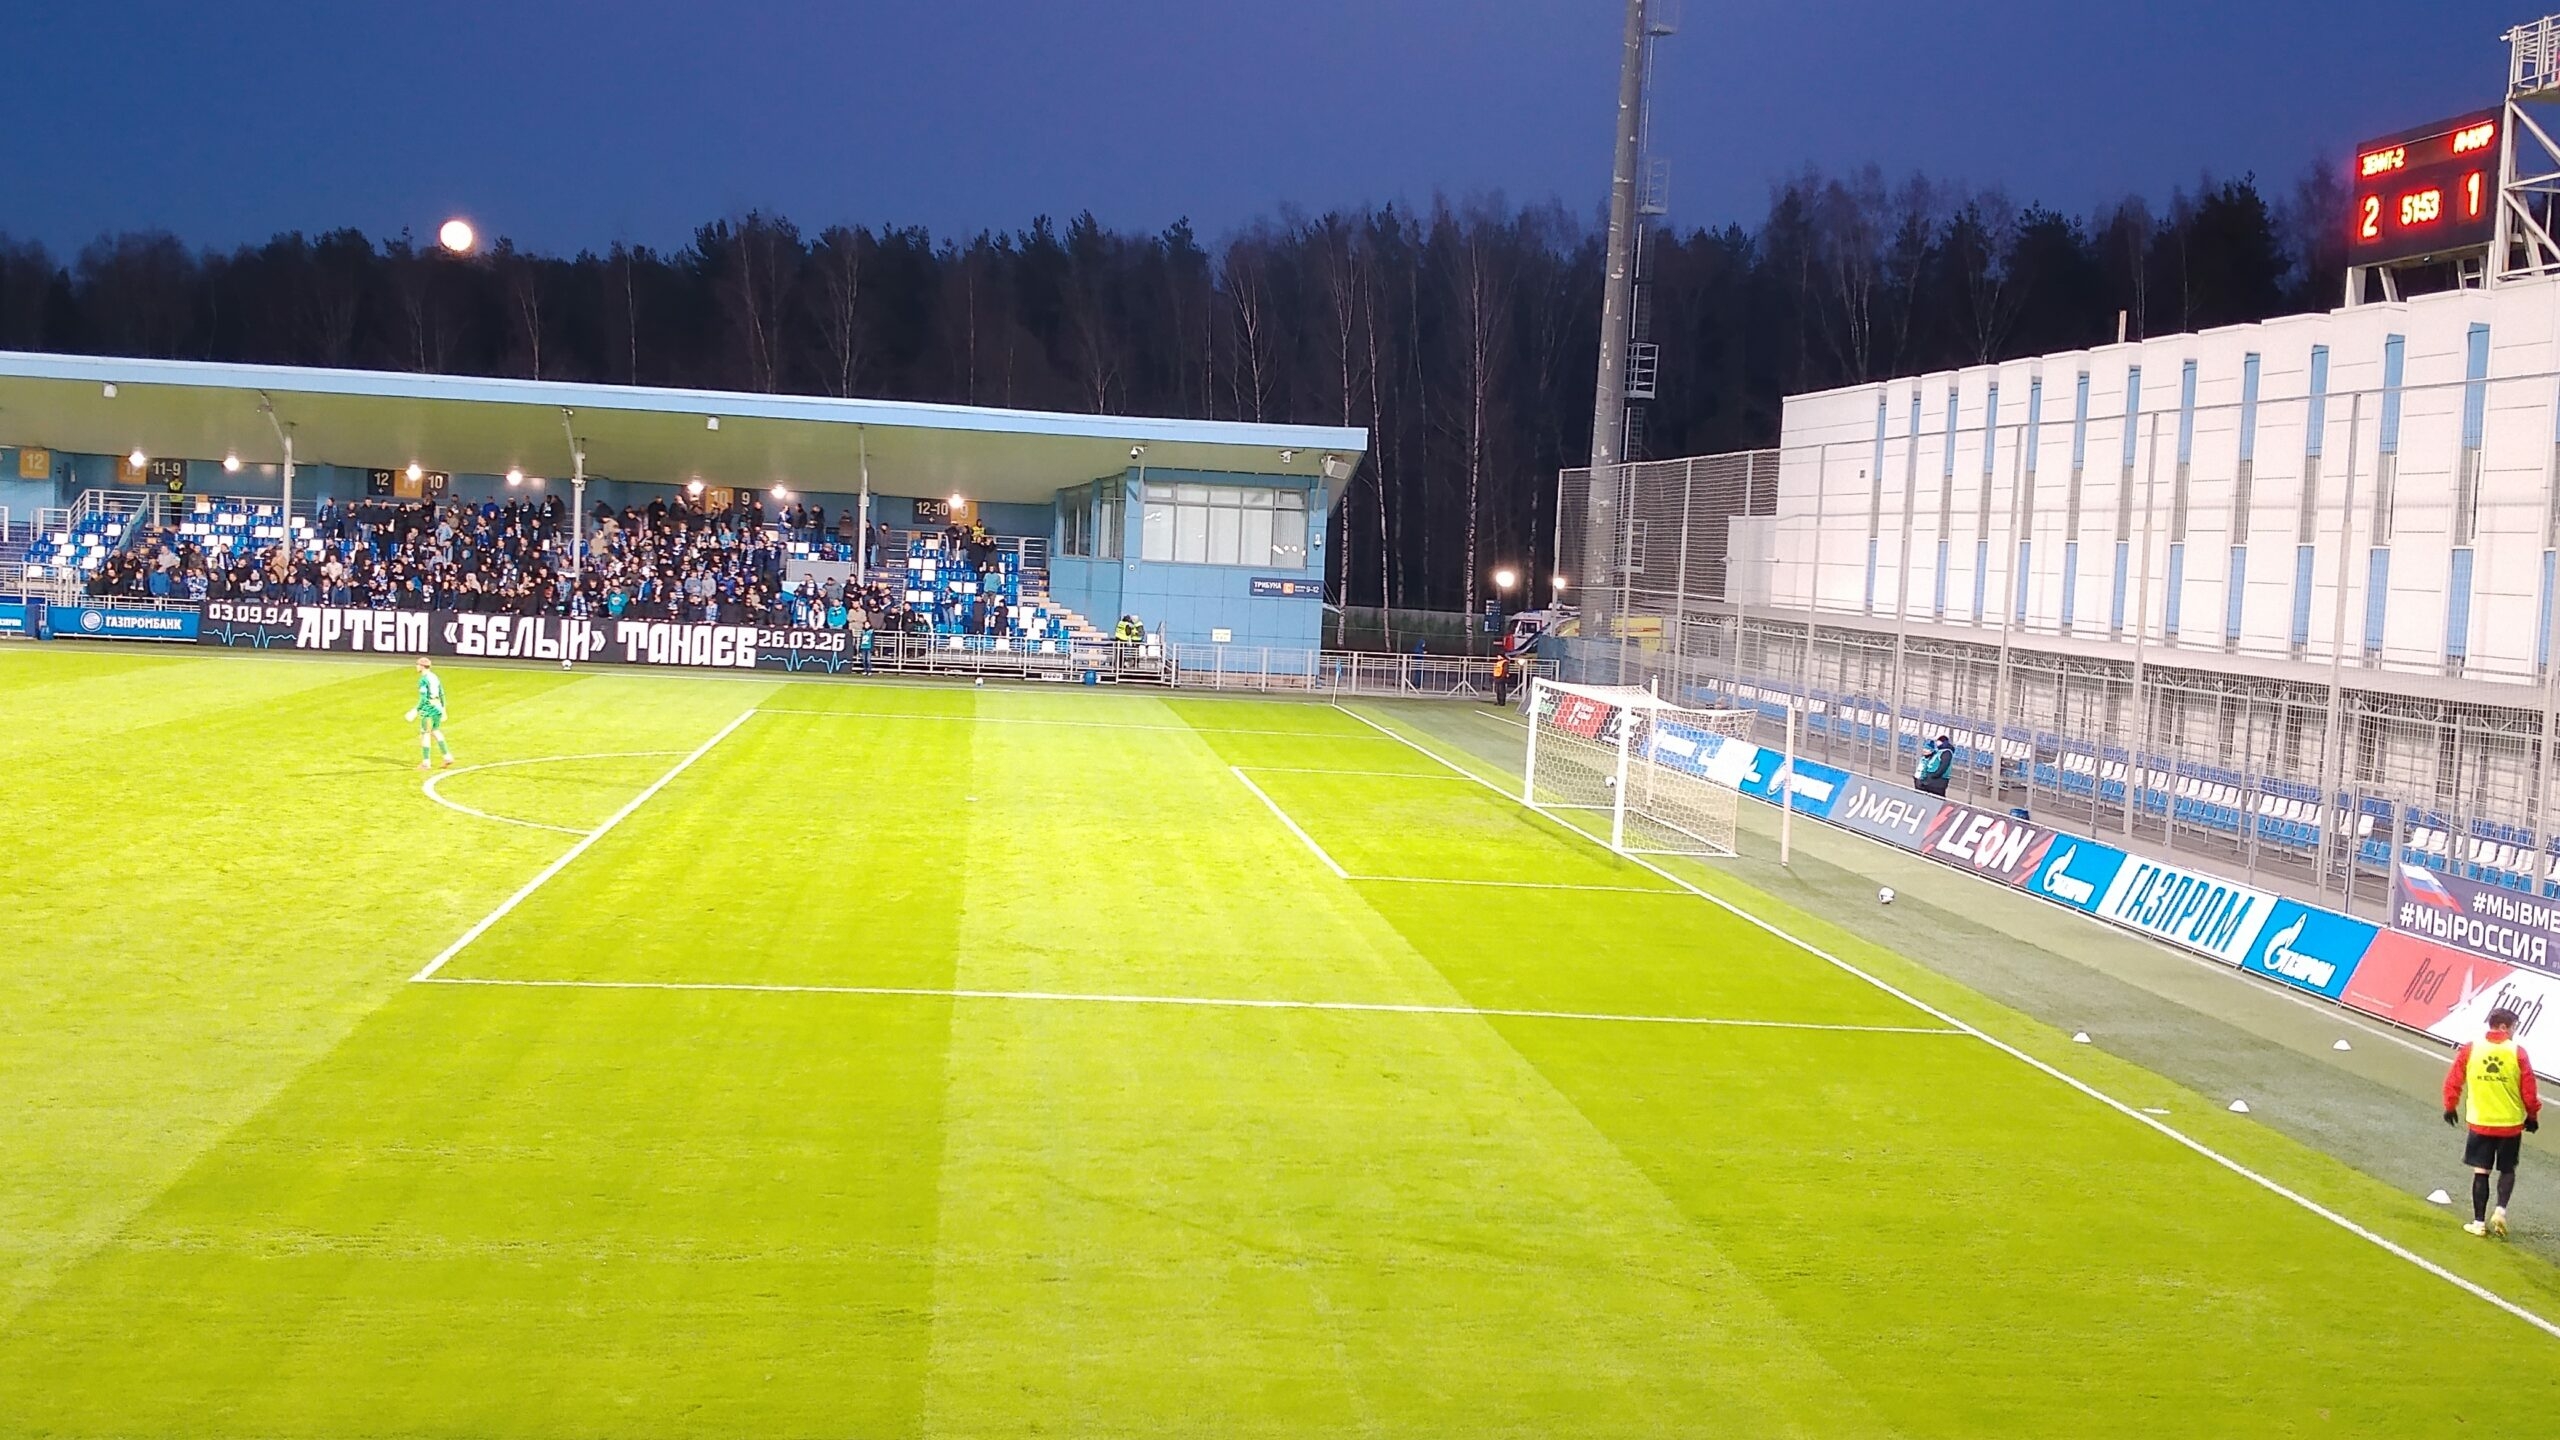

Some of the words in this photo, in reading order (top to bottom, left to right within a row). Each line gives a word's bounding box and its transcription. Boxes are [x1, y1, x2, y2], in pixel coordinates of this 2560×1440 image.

[2467, 172, 2481, 216] 1
[2362, 195, 2380, 238] 2
[26, 453, 44, 470] 12
[152, 461, 182, 477] 11-9
[374, 472, 390, 487] 12
[427, 475, 444, 489] 10
[741, 491, 751, 505] 9
[916, 502, 949, 516] 12-10
[1254, 581, 1282, 589] ТРИБУНА
[105, 616, 182, 631] ГАЗПРОМБАНК
[208, 603, 294, 627] 03.09.94
[296, 606, 430, 653] АРТЕМ
[617, 620, 758, 669] ТАНАЕВ
[758, 630, 846, 652] 26.03.26
[1936, 810, 2036, 874] LEON
[2115, 863, 2256, 953] ГАЗПРОМ
[2472, 891, 2560, 934] #МЫВМЕ
[2400, 901, 2548, 966] #МЫРОССИЯ
[2404, 957, 2453, 1005] Red
